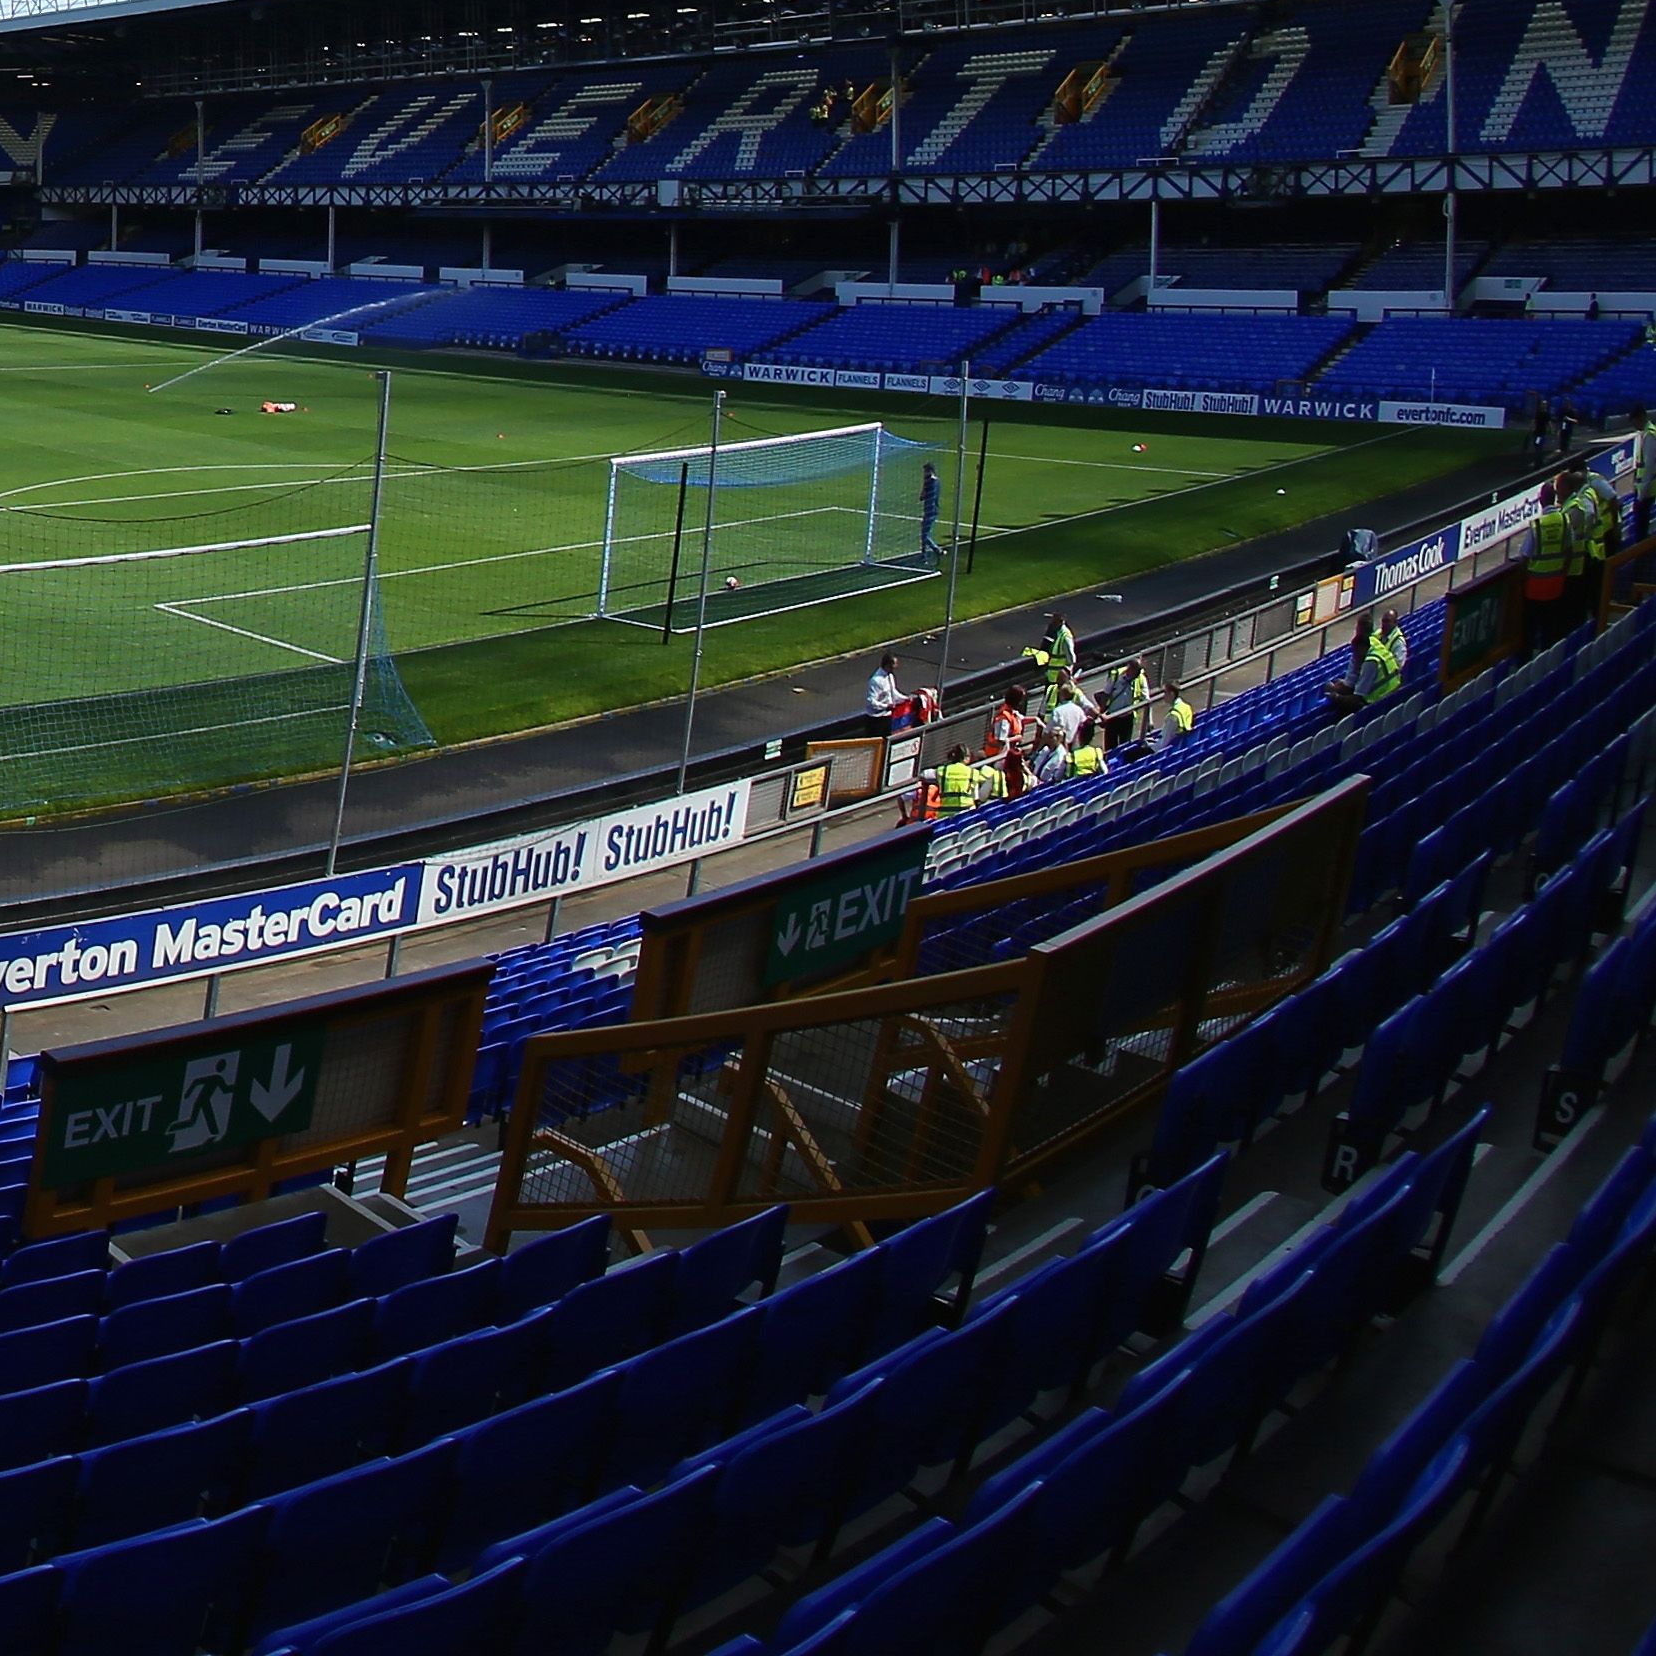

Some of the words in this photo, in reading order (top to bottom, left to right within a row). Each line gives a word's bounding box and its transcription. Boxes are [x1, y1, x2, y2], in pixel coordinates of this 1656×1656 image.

[26, 302, 63, 313] WARWICK
[749, 366, 830, 383] WARWICK
[838, 374, 878, 386] FLANNELS
[886, 377, 927, 389] FLANNELS
[1145, 391, 1195, 410] StubHub!
[1202, 394, 1254, 413] StubHub!
[1264, 398, 1373, 420] WARWICK
[1397, 407, 1485, 426] evertonfc.com
[1464, 519, 1496, 549] Everton
[1374, 553, 1420, 595] Thomas
[1418, 537, 1445, 574] Cook
[432, 833, 586, 914] StubHub!
[603, 791, 740, 870] StubHub!
[833, 865, 921, 942] EXIT
[152, 878, 406, 969] MasterCard
[63, 1093, 164, 1150] EXIT
[1554, 1090, 1579, 1125] S
[1331, 1144, 1358, 1182] R
